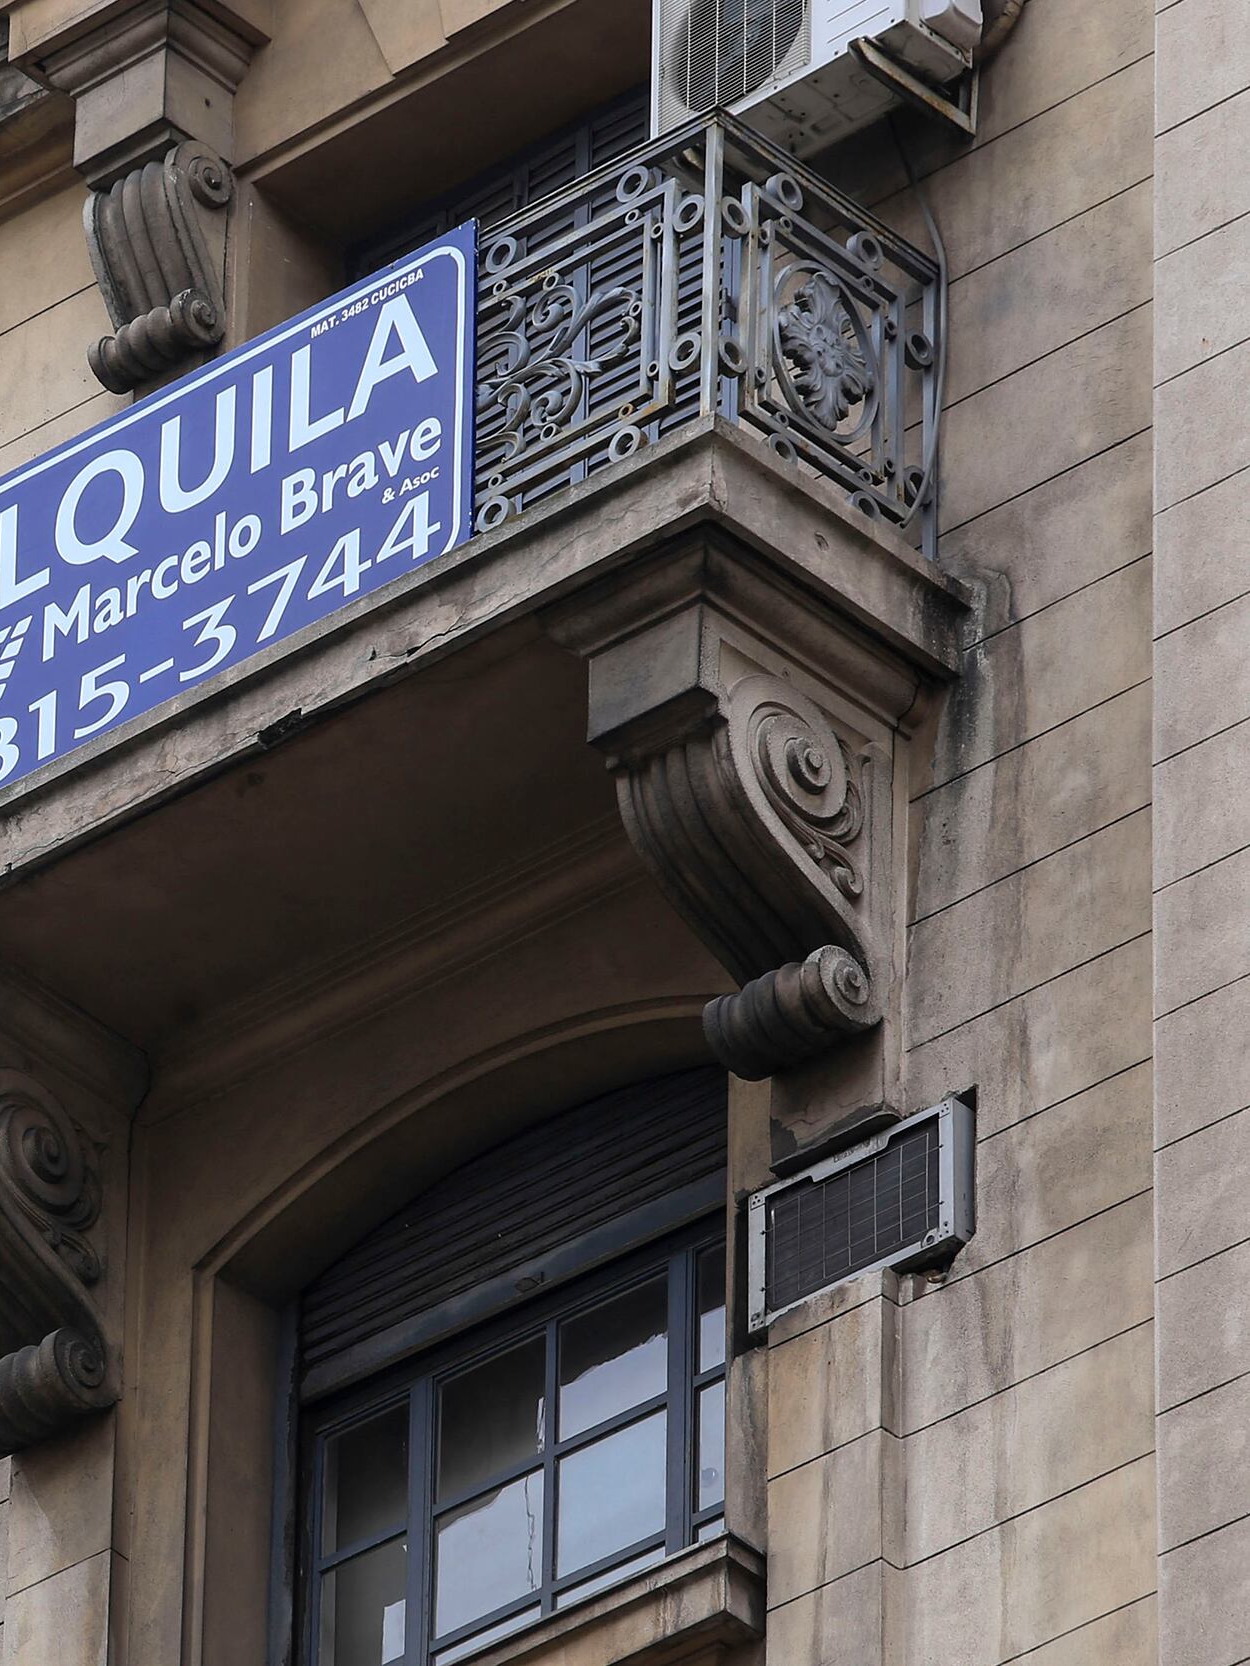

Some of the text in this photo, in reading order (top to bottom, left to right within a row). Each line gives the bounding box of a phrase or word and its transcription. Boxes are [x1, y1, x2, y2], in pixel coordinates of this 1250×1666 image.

[311, 268, 424, 338] MAT. 3482 CUCICBA
[381, 466, 439, 504] & Asoc
[43, 418, 441, 662] Marcelo Brave
